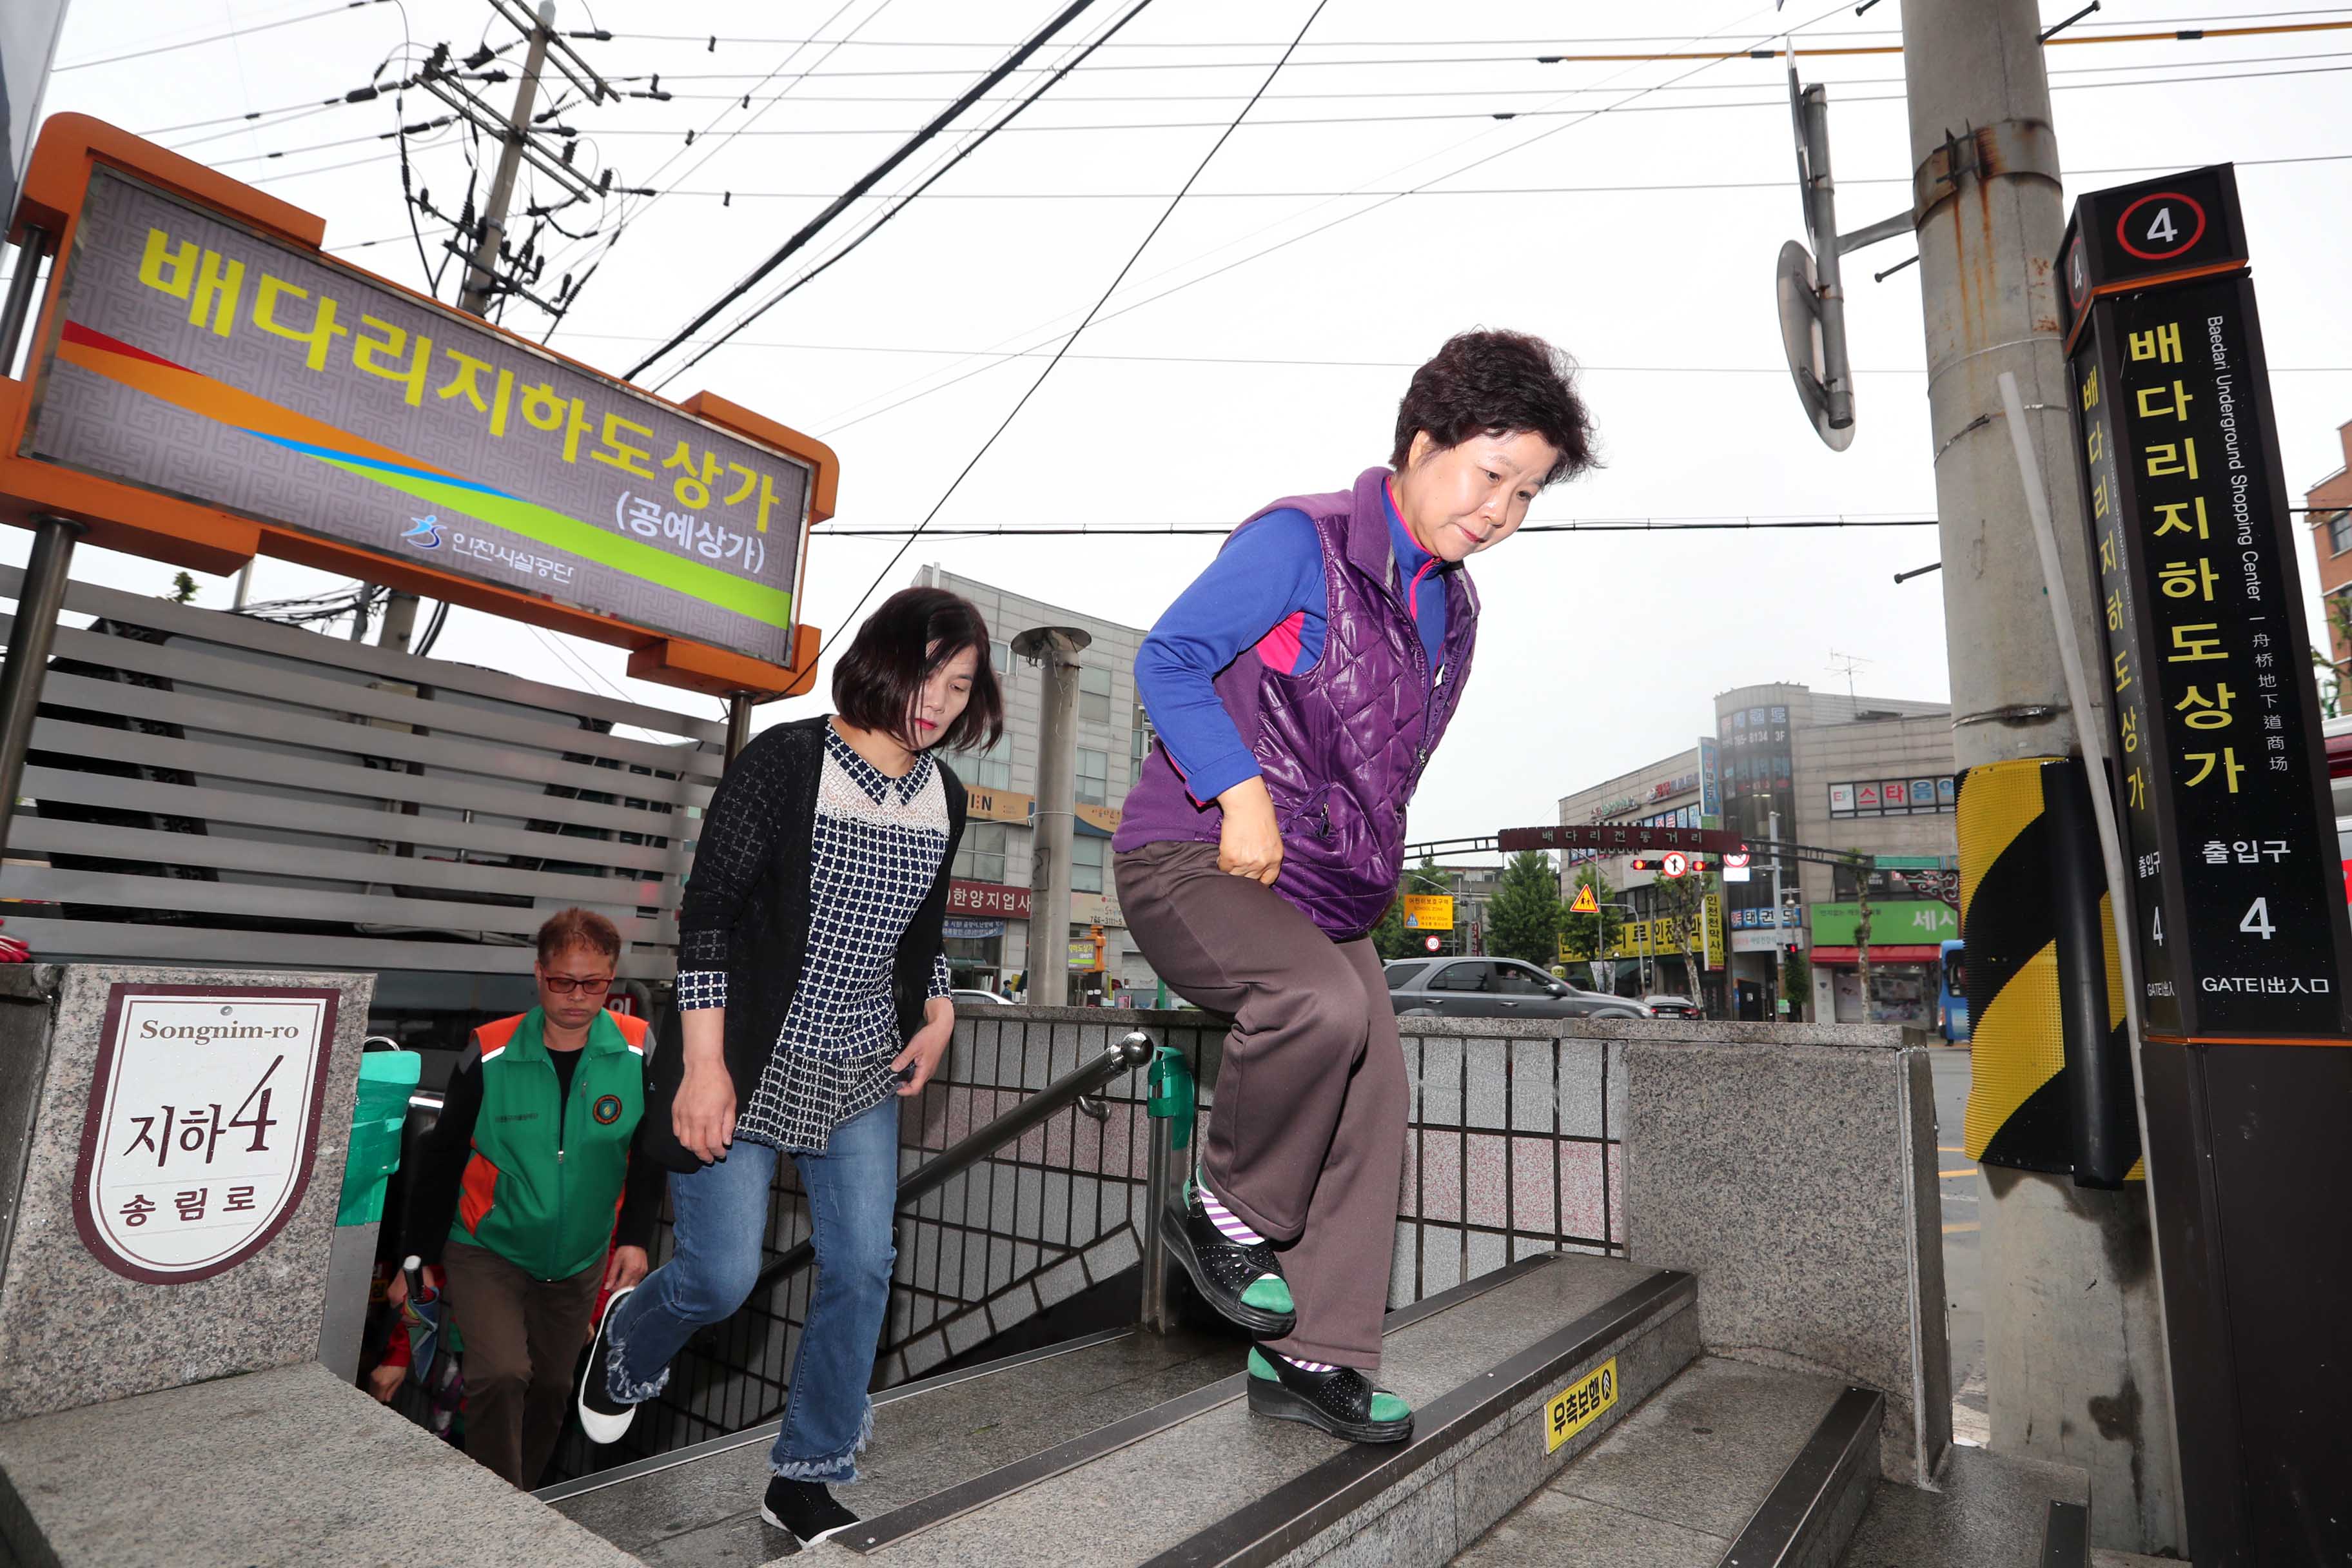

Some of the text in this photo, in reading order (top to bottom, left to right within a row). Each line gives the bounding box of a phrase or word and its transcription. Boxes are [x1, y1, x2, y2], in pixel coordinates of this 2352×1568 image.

[2147, 208, 2179, 243] 4
[2073, 253, 2082, 290] 4
[138, 228, 779, 534] 배다리지하도상가
[2207, 316, 2261, 601] Baedari Underground Shopping Center
[616, 491, 765, 574] (공예상가)
[2129, 322, 2245, 793] 배다리지하도상가
[453, 533, 574, 583] 인천시설공단
[2082, 366, 2146, 810] 배다리지하도상가
[2253, 632, 2288, 772] 舟桥地下道商场
[2139, 851, 2161, 879] 출입구
[2202, 840, 2291, 864] 출입구
[2152, 906, 2163, 946] 4
[2240, 897, 2277, 940] 4
[140, 1020, 299, 1046] Songnim-ro
[1554, 1376, 1601, 1436] 우측보행
